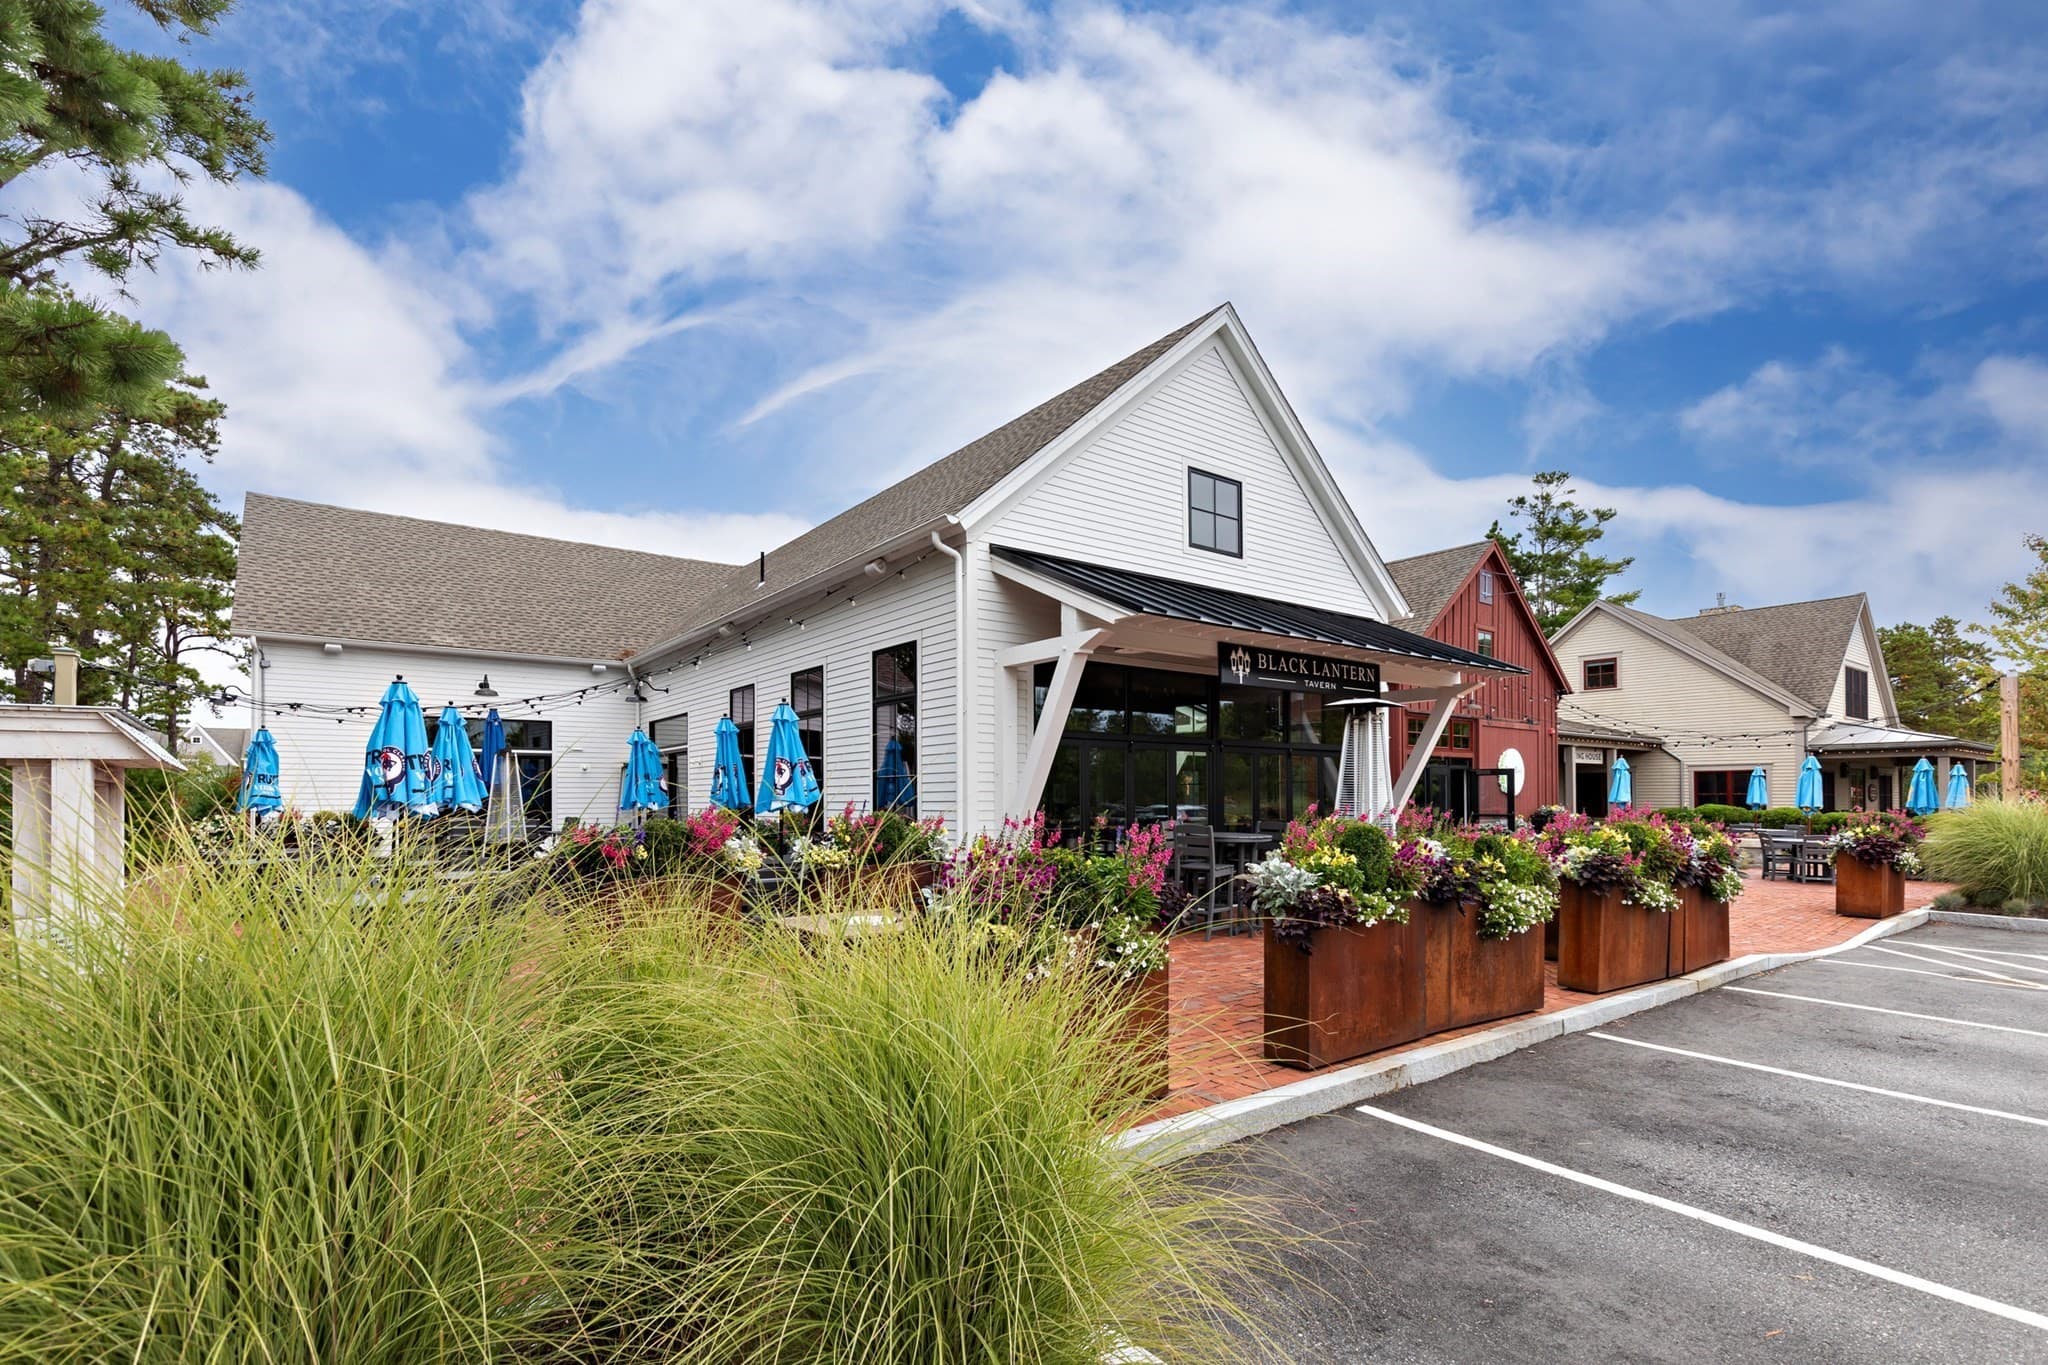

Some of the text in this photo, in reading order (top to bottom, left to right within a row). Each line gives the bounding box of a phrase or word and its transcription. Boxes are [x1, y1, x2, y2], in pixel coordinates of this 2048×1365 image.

[1258, 653, 1375, 682] BLACK LANTERN
[1304, 679, 1337, 690] TAVERN
